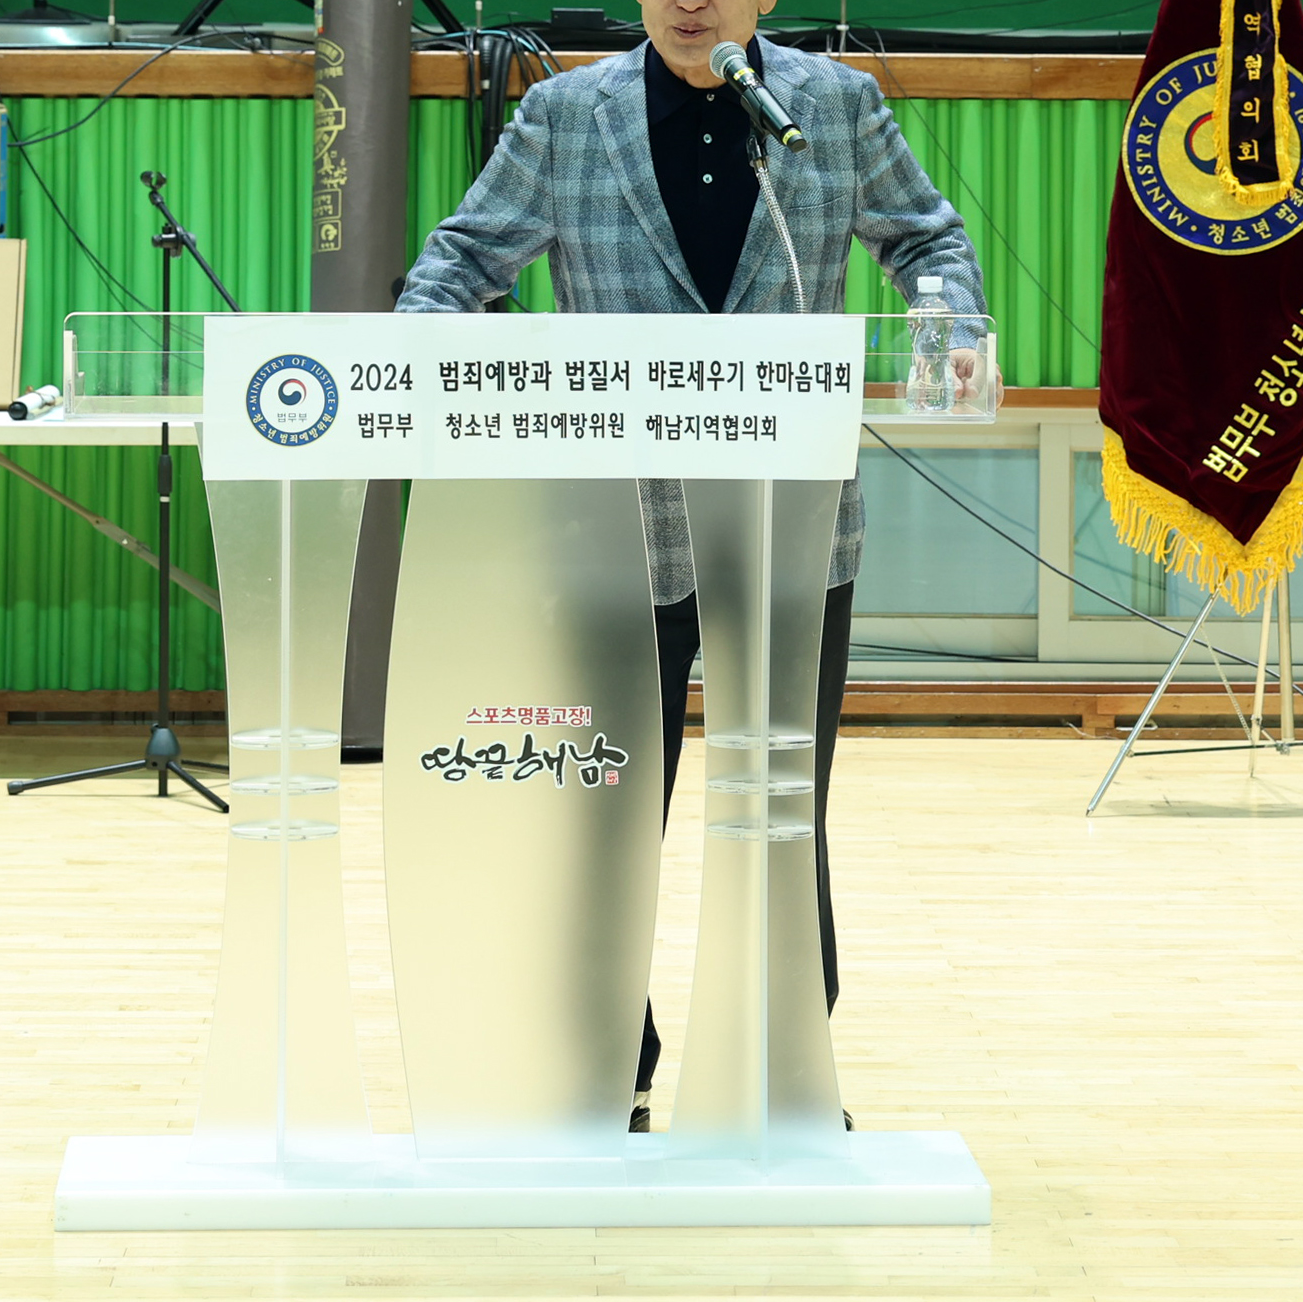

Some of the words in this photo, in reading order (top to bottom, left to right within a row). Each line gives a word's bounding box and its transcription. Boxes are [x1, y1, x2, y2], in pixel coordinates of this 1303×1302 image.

[1154, 76, 1184, 106] OF
[1135, 115, 1190, 227] MINISTRY
[1207, 217, 1272, 245] 청소년
[249, 359, 286, 404] MINISTRY
[291, 357, 308, 367] OF
[310, 364, 336, 404] JUSTICE
[350, 363, 413, 391] 2024
[439, 361, 552, 391] 범죄예방과
[565, 360, 631, 391] 법질서
[648, 360, 745, 391] 바로세우기
[756, 360, 852, 393] 한마음대회
[277, 413, 307, 423] 법무부
[357, 413, 414, 438] 법무부
[445, 413, 502, 439] 청소년
[512, 412, 625, 439] 범죄예방위원
[646, 413, 778, 441] 해남지역협의회
[1202, 402, 1276, 483] 법무부
[466, 707, 591, 726] 스포츠명품고장!
[420, 733, 627, 786] 땅끝해남
